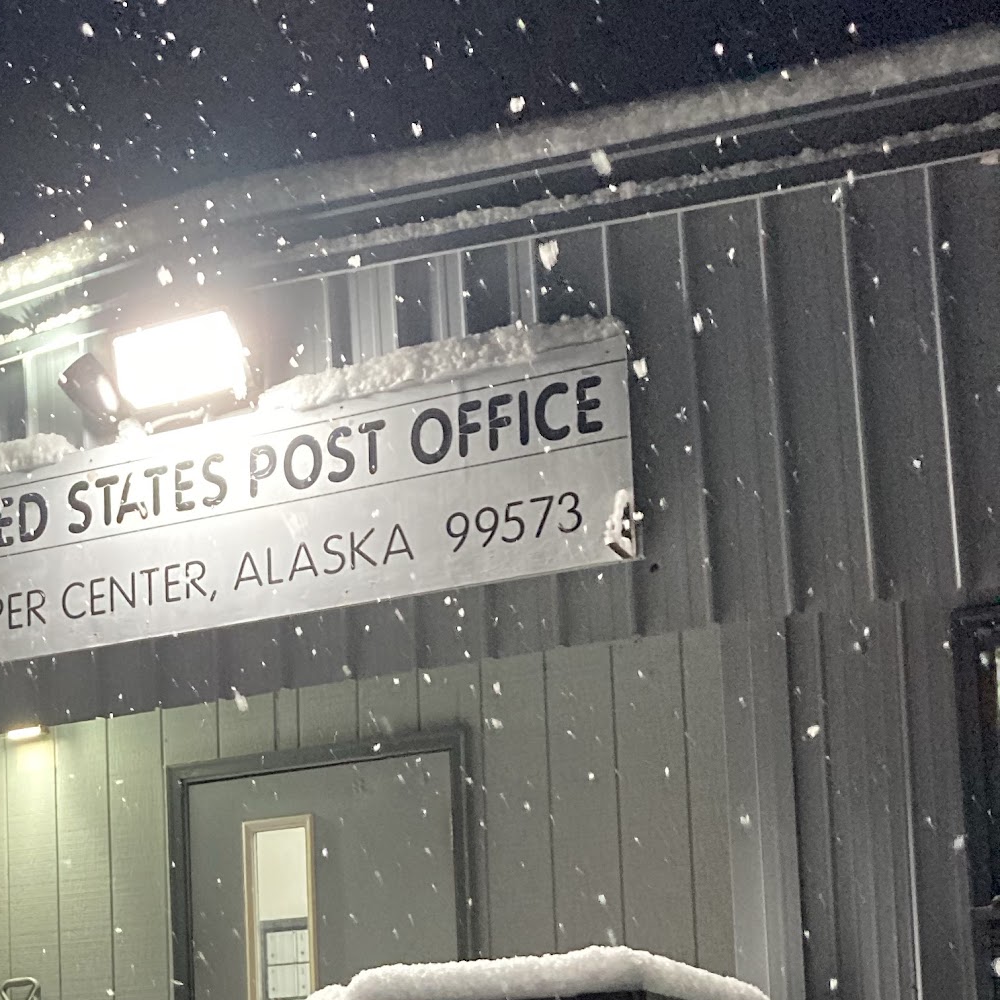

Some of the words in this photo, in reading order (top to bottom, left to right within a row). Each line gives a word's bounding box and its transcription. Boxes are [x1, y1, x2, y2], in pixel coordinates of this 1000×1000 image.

[67, 453, 228, 534] STATES
[250, 419, 386, 498] POST
[410, 375, 603, 465] OFFICE
[61, 559, 217, 619] CENTER,
[234, 522, 415, 591] ALASKA
[446, 491, 583, 553] 99573
